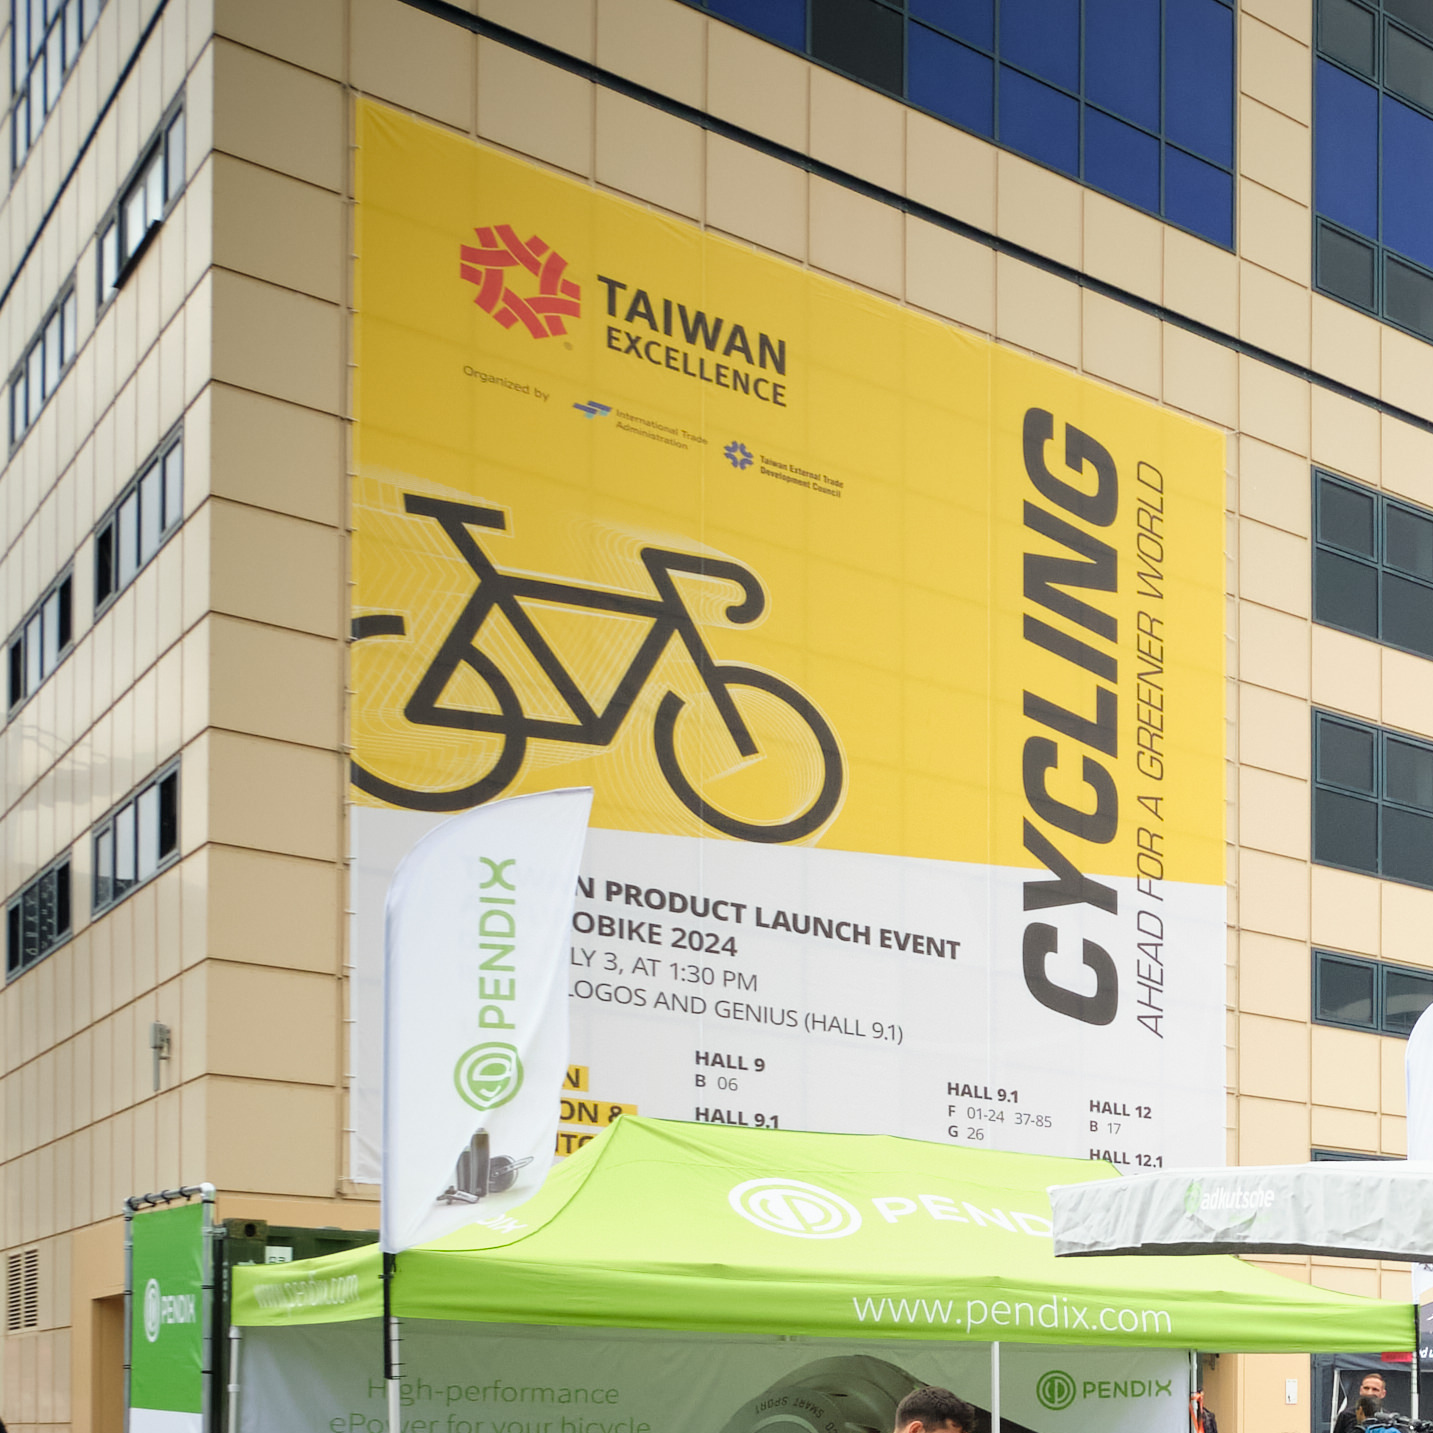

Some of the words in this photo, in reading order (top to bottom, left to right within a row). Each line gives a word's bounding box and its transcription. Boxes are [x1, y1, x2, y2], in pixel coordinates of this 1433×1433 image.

[597, 274, 787, 376] TAIWAN
[463, 364, 530, 395] Organized
[533, 385, 550, 402] by
[606, 325, 787, 407] EXCELLENCE
[615, 408, 679, 437] International
[680, 429, 708, 445] Trade
[615, 420, 689, 450] Administration
[759, 465, 810, 491] Development
[811, 481, 842, 498] Council
[760, 455, 788, 471] Taiwan
[789, 463, 821, 481] External
[823, 472, 844, 488] Trade
[1136, 460, 1164, 599] WORLD
[1136, 610, 1164, 781] GREENER
[1022, 407, 1118, 1026] CYCLING
[1136, 795, 1164, 821] A
[1136, 827, 1164, 902] FOR
[571, 910, 662, 945] OBIKE
[670, 926, 738, 958] 2024
[605, 879, 748, 924] PRODUCT
[754, 906, 872, 945] LAUNCH
[878, 928, 961, 960] EVENT
[478, 855, 517, 1030] PENDIX
[570, 946, 597, 969] LY
[603, 951, 624, 977] 3,
[631, 956, 662, 978] AT
[669, 961, 715, 986] 1:30
[723, 969, 758, 992] PM
[1136, 909, 1164, 1039] AHEAD
[653, 990, 707, 1015] AND
[714, 999, 799, 1029] GENIUS
[803, 1009, 866, 1039] (HALL
[871, 1018, 904, 1046] 9.1)
[694, 1050, 748, 1071] HALL
[754, 1056, 766, 1073] 9
[694, 1073, 707, 1088] B
[717, 1075, 738, 1092] 06
[947, 1081, 993, 1101] HALL
[996, 1087, 1019, 1104] 9.1
[694, 1106, 749, 1127] HALL
[753, 1113, 780, 1130] 9.1
[947, 1104, 957, 1118] F
[966, 1106, 1005, 1123] 01-24
[1014, 1112, 1053, 1128] 37-85
[1089, 1099, 1131, 1117] HALL
[1134, 1105, 1153, 1120] 12
[947, 1124, 959, 1138] G
[966, 1126, 985, 1141] 26
[1089, 1120, 1099, 1133] B
[1106, 1122, 1122, 1136] 17
[1089, 1148, 1131, 1166] HALL
[1134, 1153, 1164, 1169] 12.1
[872, 1193, 1053, 1238] PEND
[161, 1294, 196, 1324] PENDIX
[852, 1295, 1172, 1334] www.pendix.com
[367, 1377, 619, 1406] Hgh-performance
[1082, 1379, 1172, 1400] PENDIX
